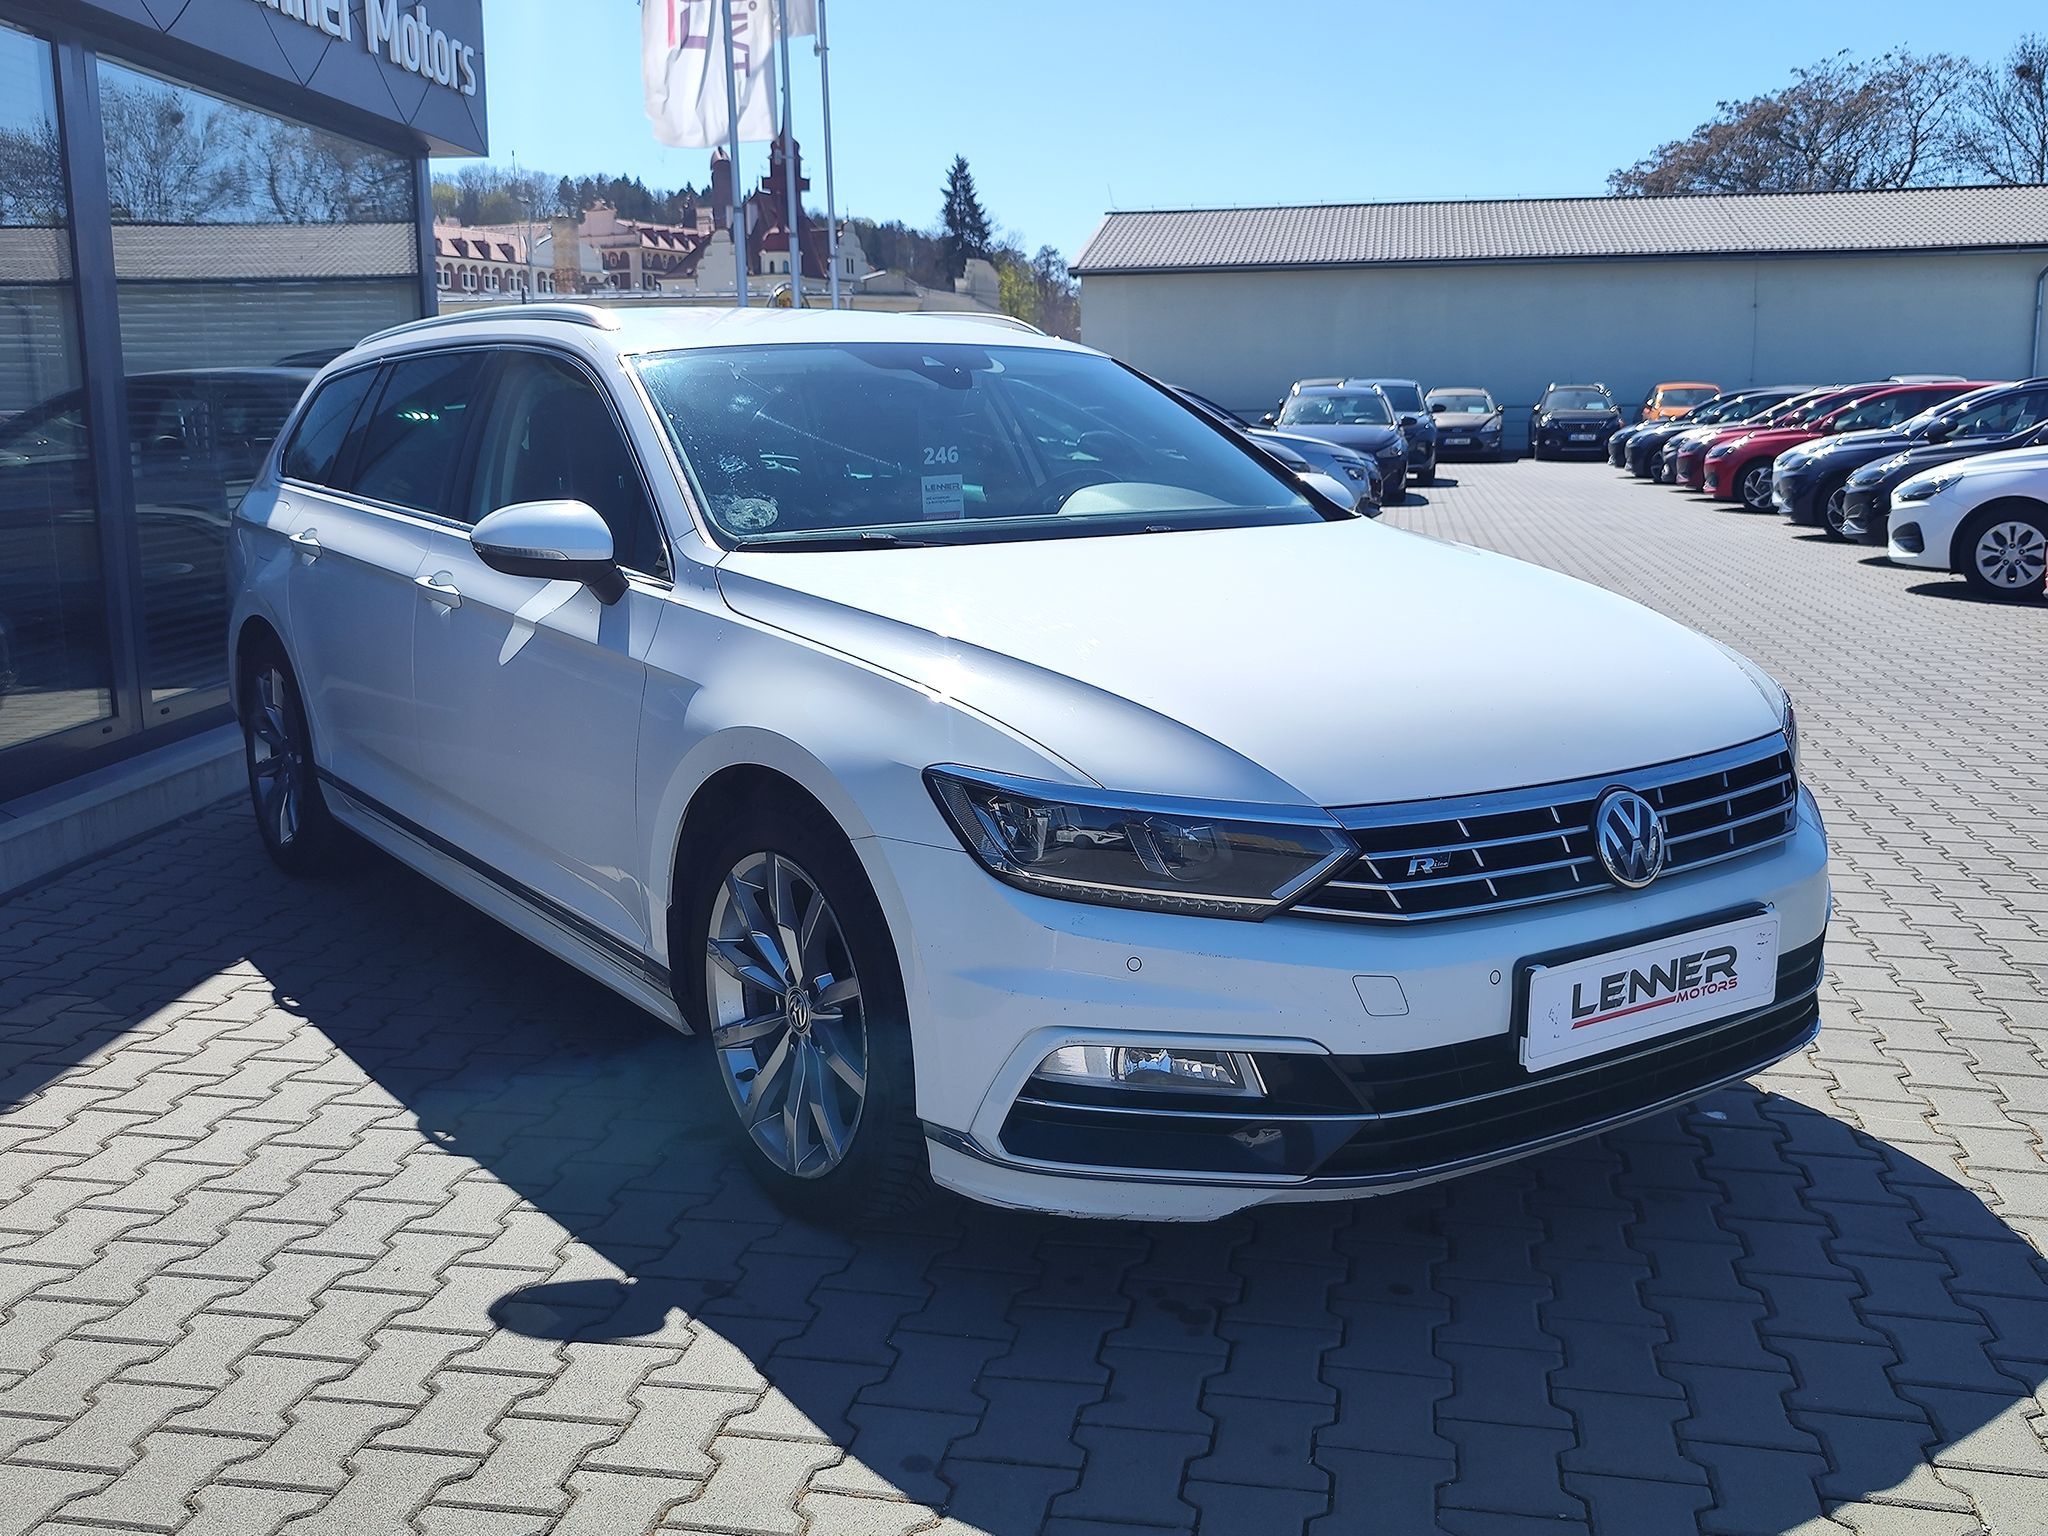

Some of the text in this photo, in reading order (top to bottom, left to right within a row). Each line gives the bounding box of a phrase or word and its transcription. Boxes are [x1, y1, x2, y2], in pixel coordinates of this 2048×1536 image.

[364, 0, 477, 97] Motors
[923, 446, 959, 465] 246
[1571, 945, 1738, 1020] LENNER
[1676, 977, 1738, 1004] MOTORS
